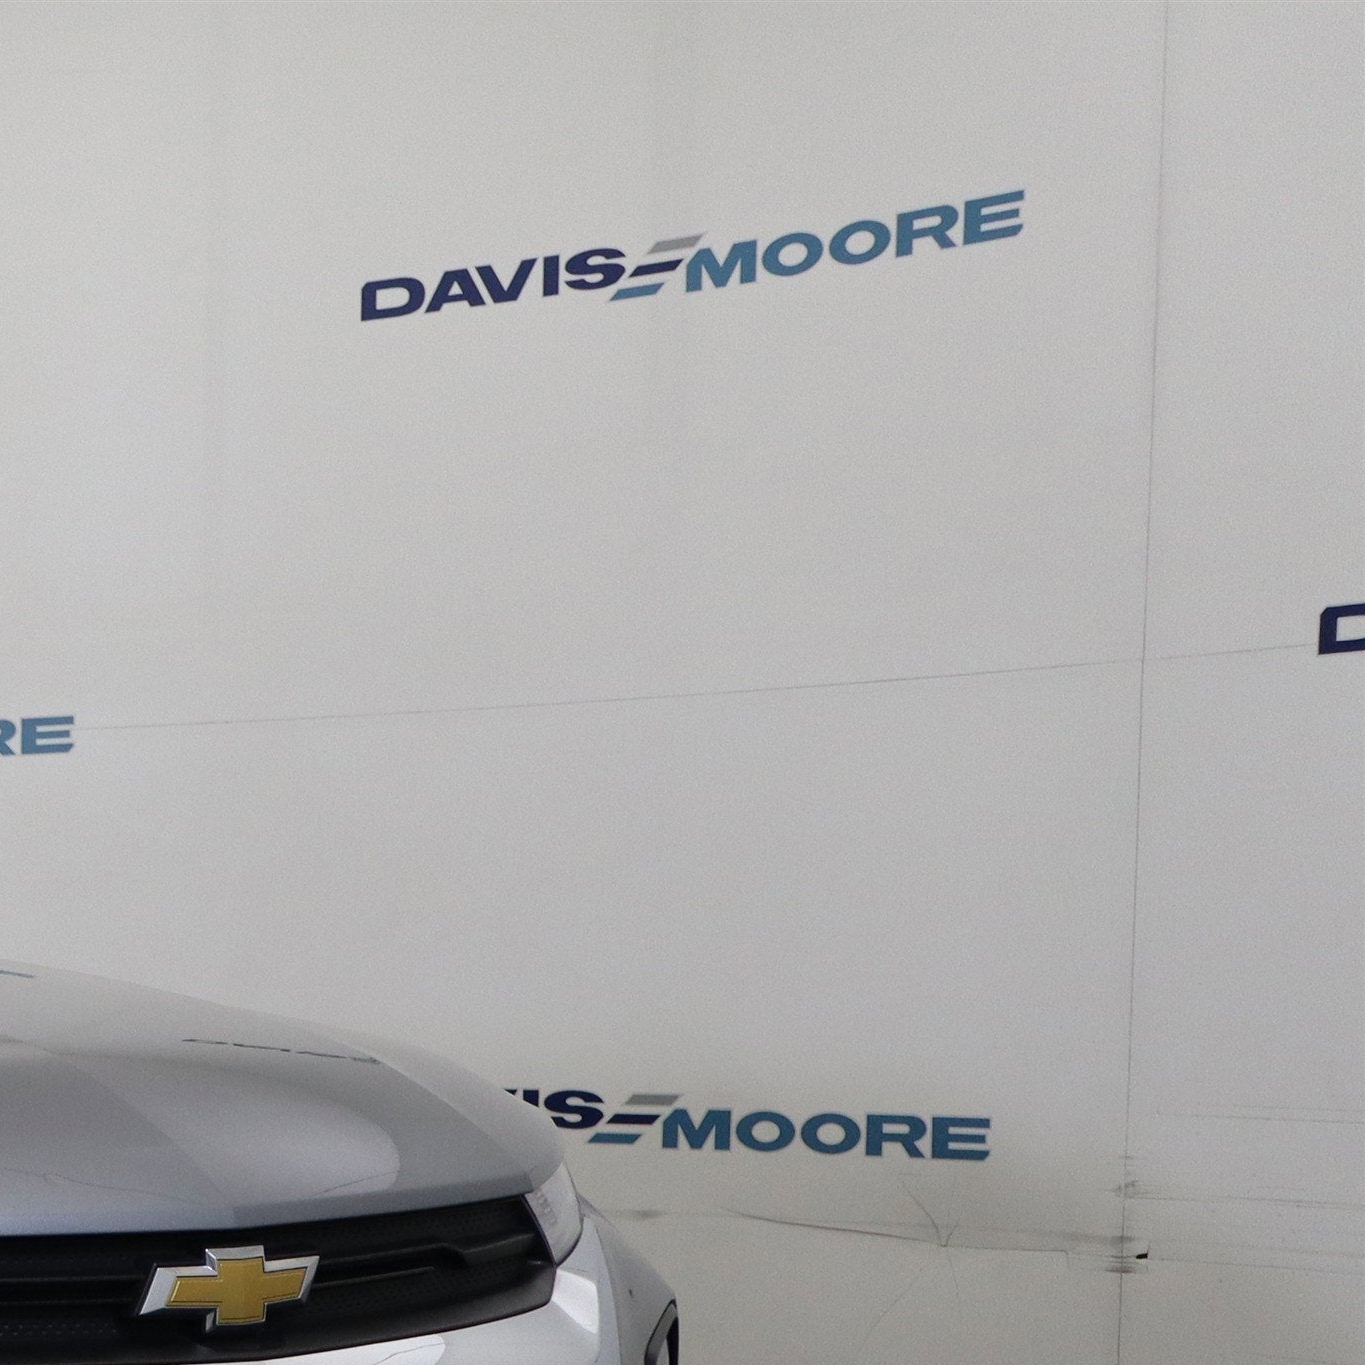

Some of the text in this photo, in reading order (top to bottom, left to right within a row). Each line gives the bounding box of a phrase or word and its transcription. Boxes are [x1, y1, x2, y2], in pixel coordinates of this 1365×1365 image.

[360, 190, 1025, 322] DAVIS MOORE
[661, 1107, 992, 1163] MOORE
